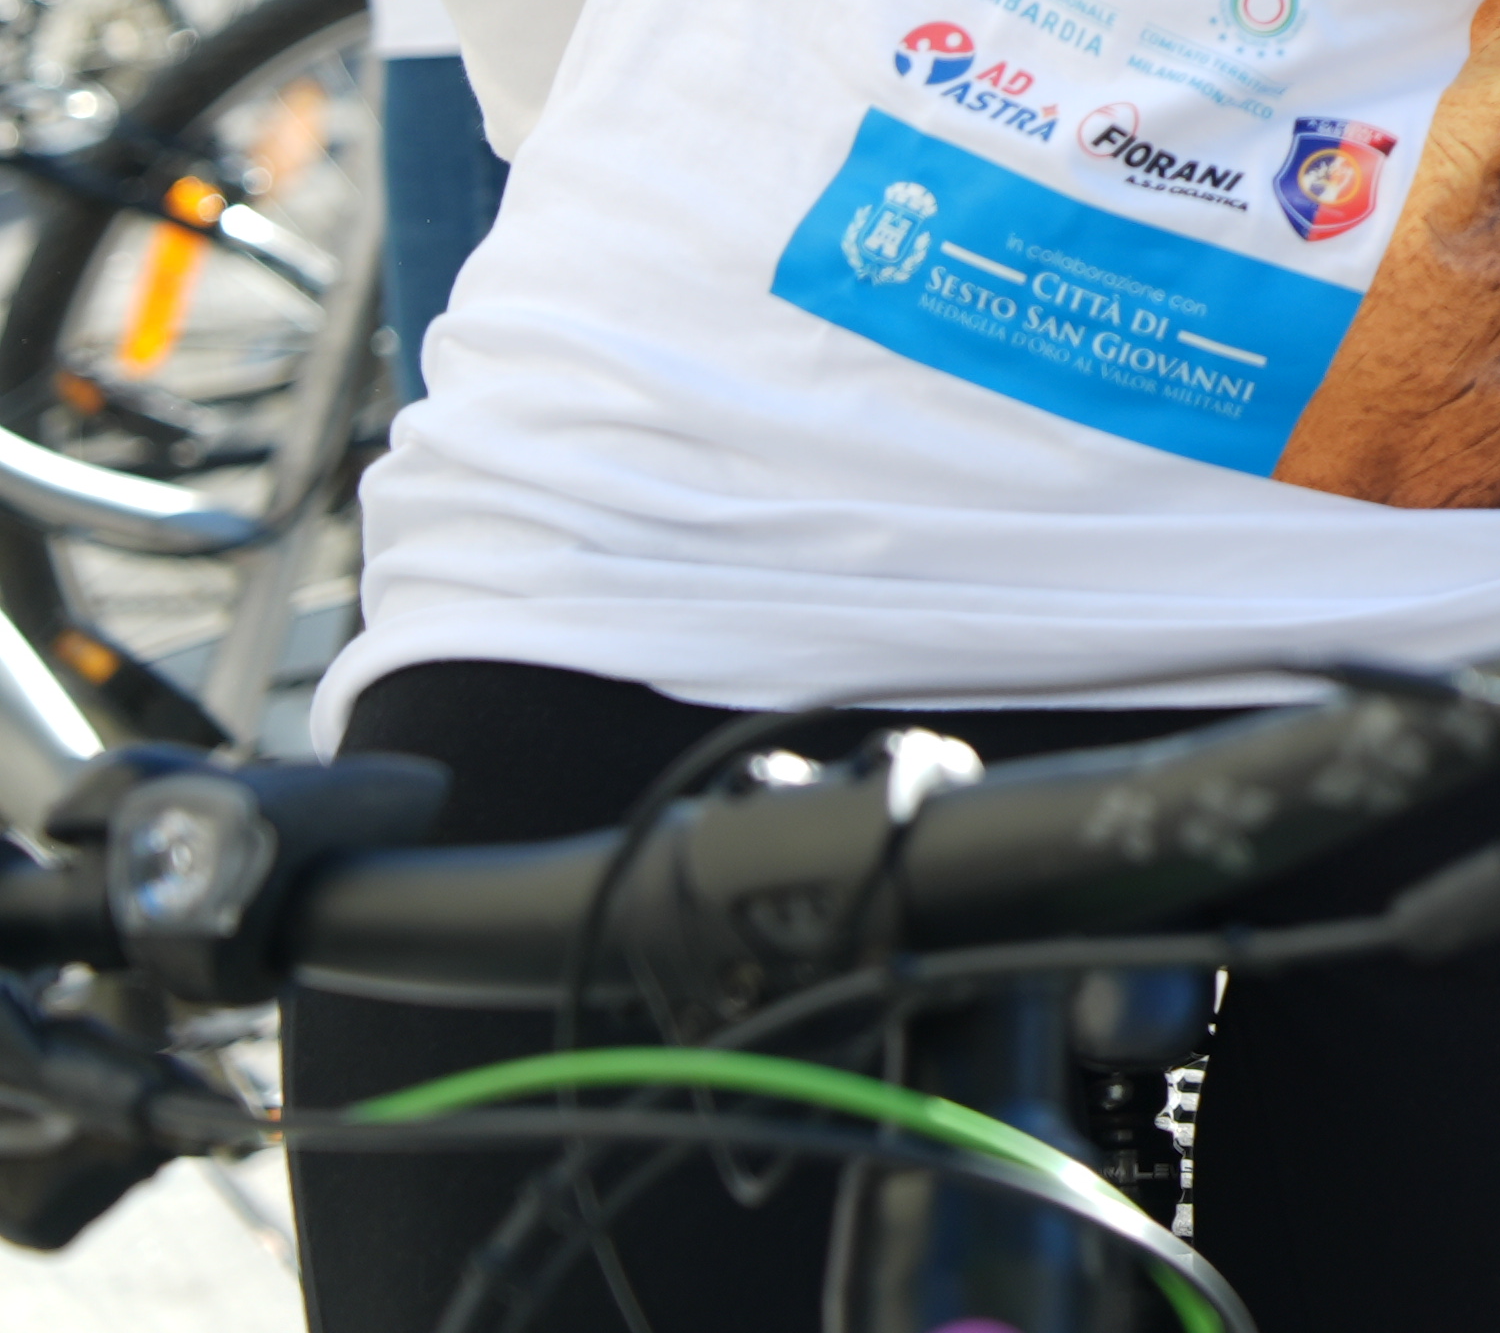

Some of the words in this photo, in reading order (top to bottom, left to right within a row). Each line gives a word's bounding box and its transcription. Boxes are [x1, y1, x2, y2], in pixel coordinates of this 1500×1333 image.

[940, 80, 1060, 144] ASTRA
[976, 60, 1036, 97] AD
[1090, 123, 1245, 193] FIORANI
[1004, 231, 1024, 254] in
[1025, 243, 1167, 305] collaborazione
[1167, 294, 1208, 316] con
[917, 293, 1008, 340] MEDAGLIA
[1073, 355, 1094, 375] AL
[1099, 364, 1158, 395] VALOR
[1161, 383, 1245, 420] MILITARE
[924, 264, 1018, 321] SESTO
[1026, 304, 1087, 348] SAN
[1091, 331, 1257, 403] GIOVANNI
[1130, 310, 1170, 340] DI
